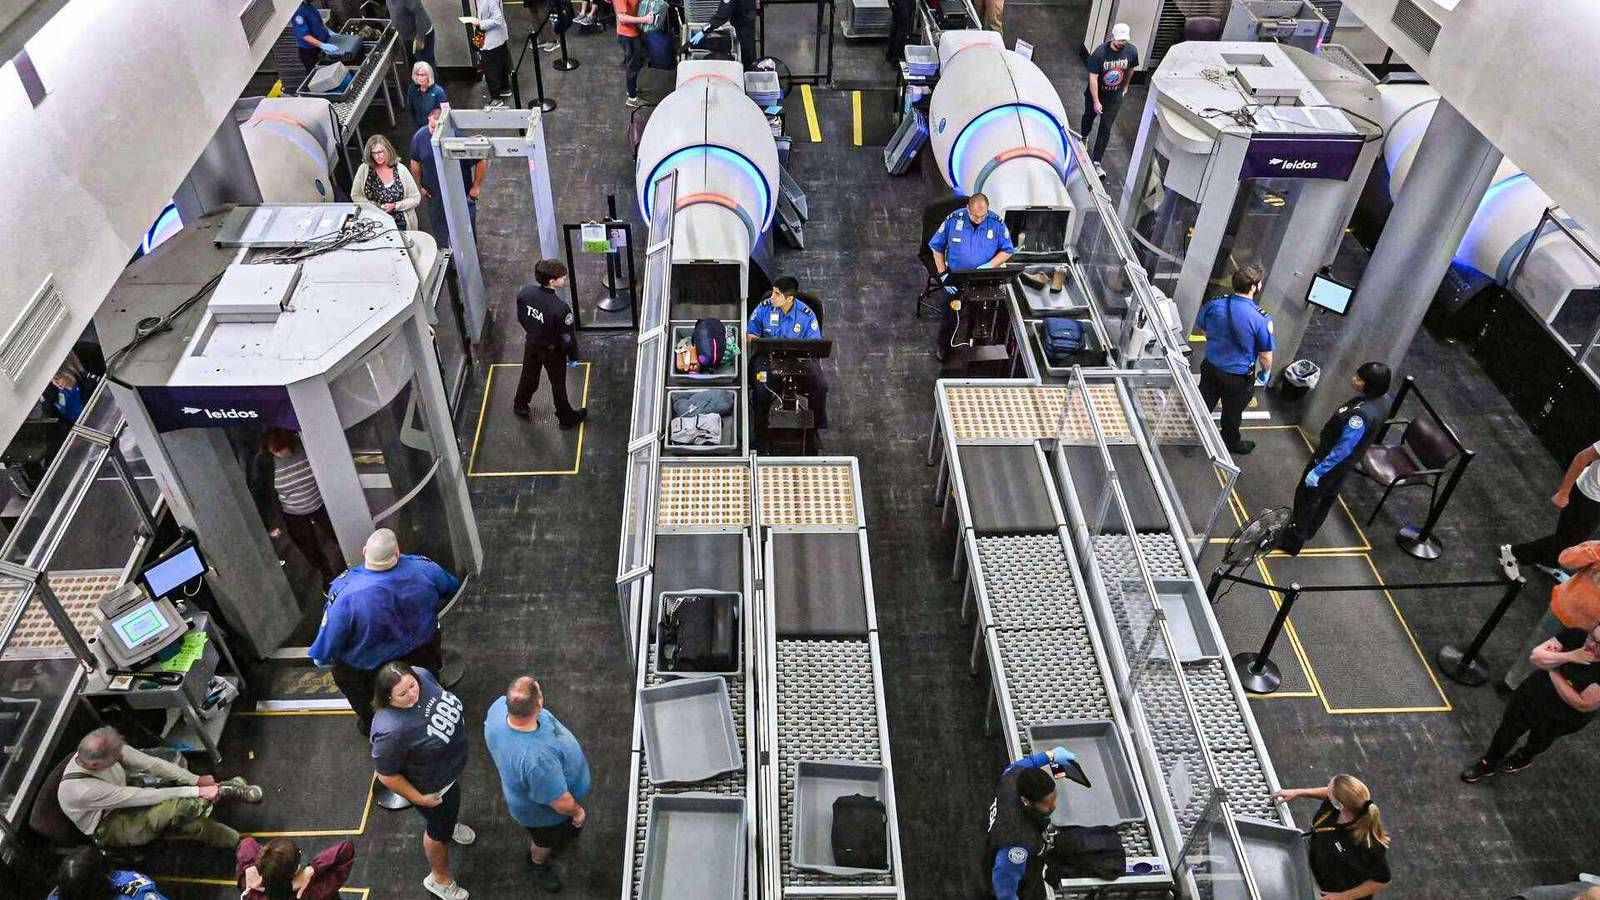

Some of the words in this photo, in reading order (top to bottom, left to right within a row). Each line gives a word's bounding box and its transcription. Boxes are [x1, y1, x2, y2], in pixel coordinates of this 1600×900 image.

[1281, 159, 1318, 170] leidos
[526, 305, 545, 324] TSA
[204, 408, 259, 419] leidos
[426, 689, 463, 744] 1985
[987, 796, 998, 833] TSA
